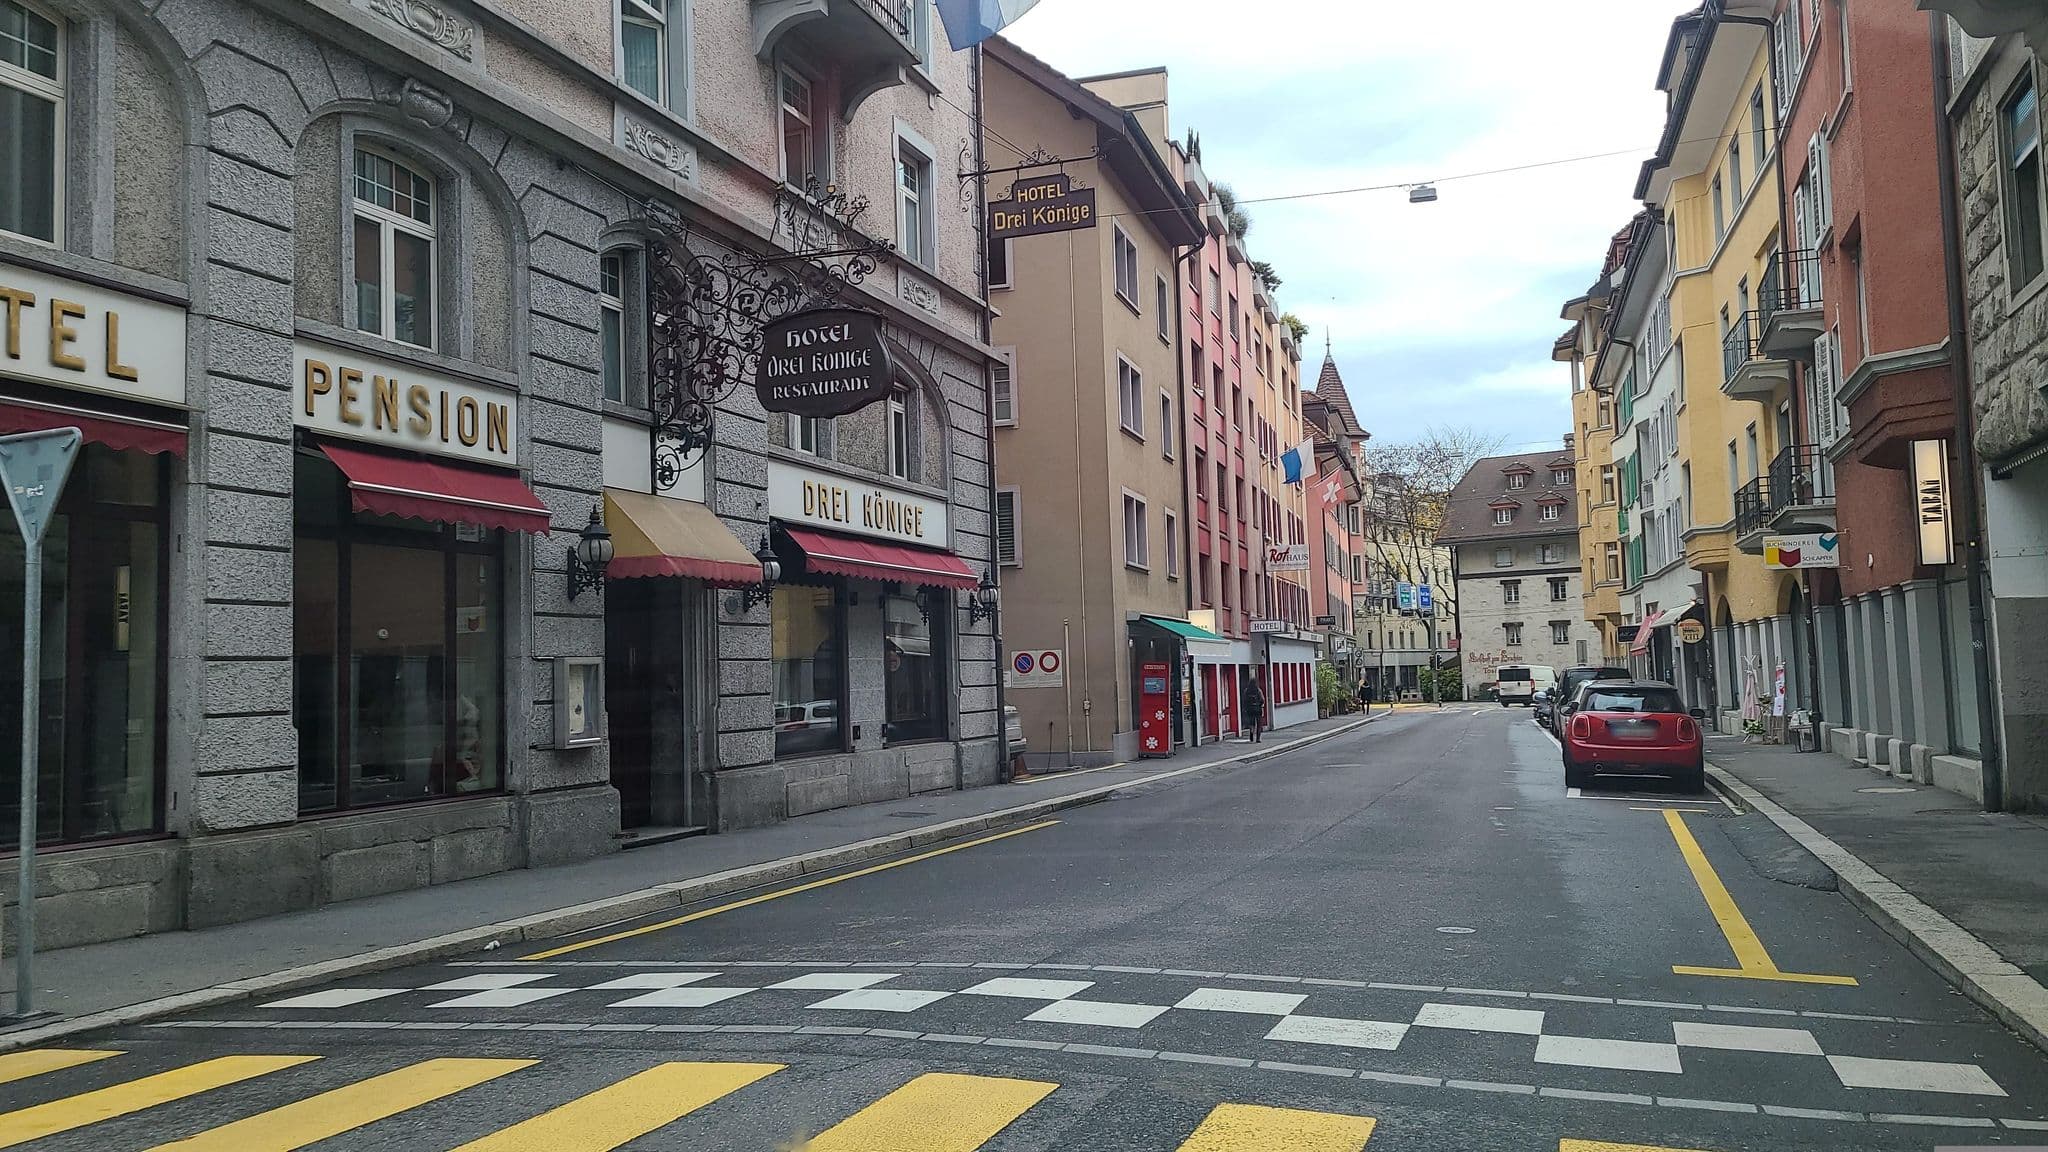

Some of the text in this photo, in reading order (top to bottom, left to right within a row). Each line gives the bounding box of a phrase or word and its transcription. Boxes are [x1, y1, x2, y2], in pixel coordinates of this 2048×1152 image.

[1017, 184, 1065, 203] HOTEL
[994, 203, 1090, 231] Drei Könige
[0, 286, 138, 382] TEL
[786, 323, 853, 348] HOTEL
[768, 355, 803, 378] DREI
[773, 376, 870, 400] RESTAURANT
[305, 358, 508, 454] PENSION
[803, 479, 923, 538] DREI KÖNIGE
[1254, 622, 1279, 630] HOTEL
